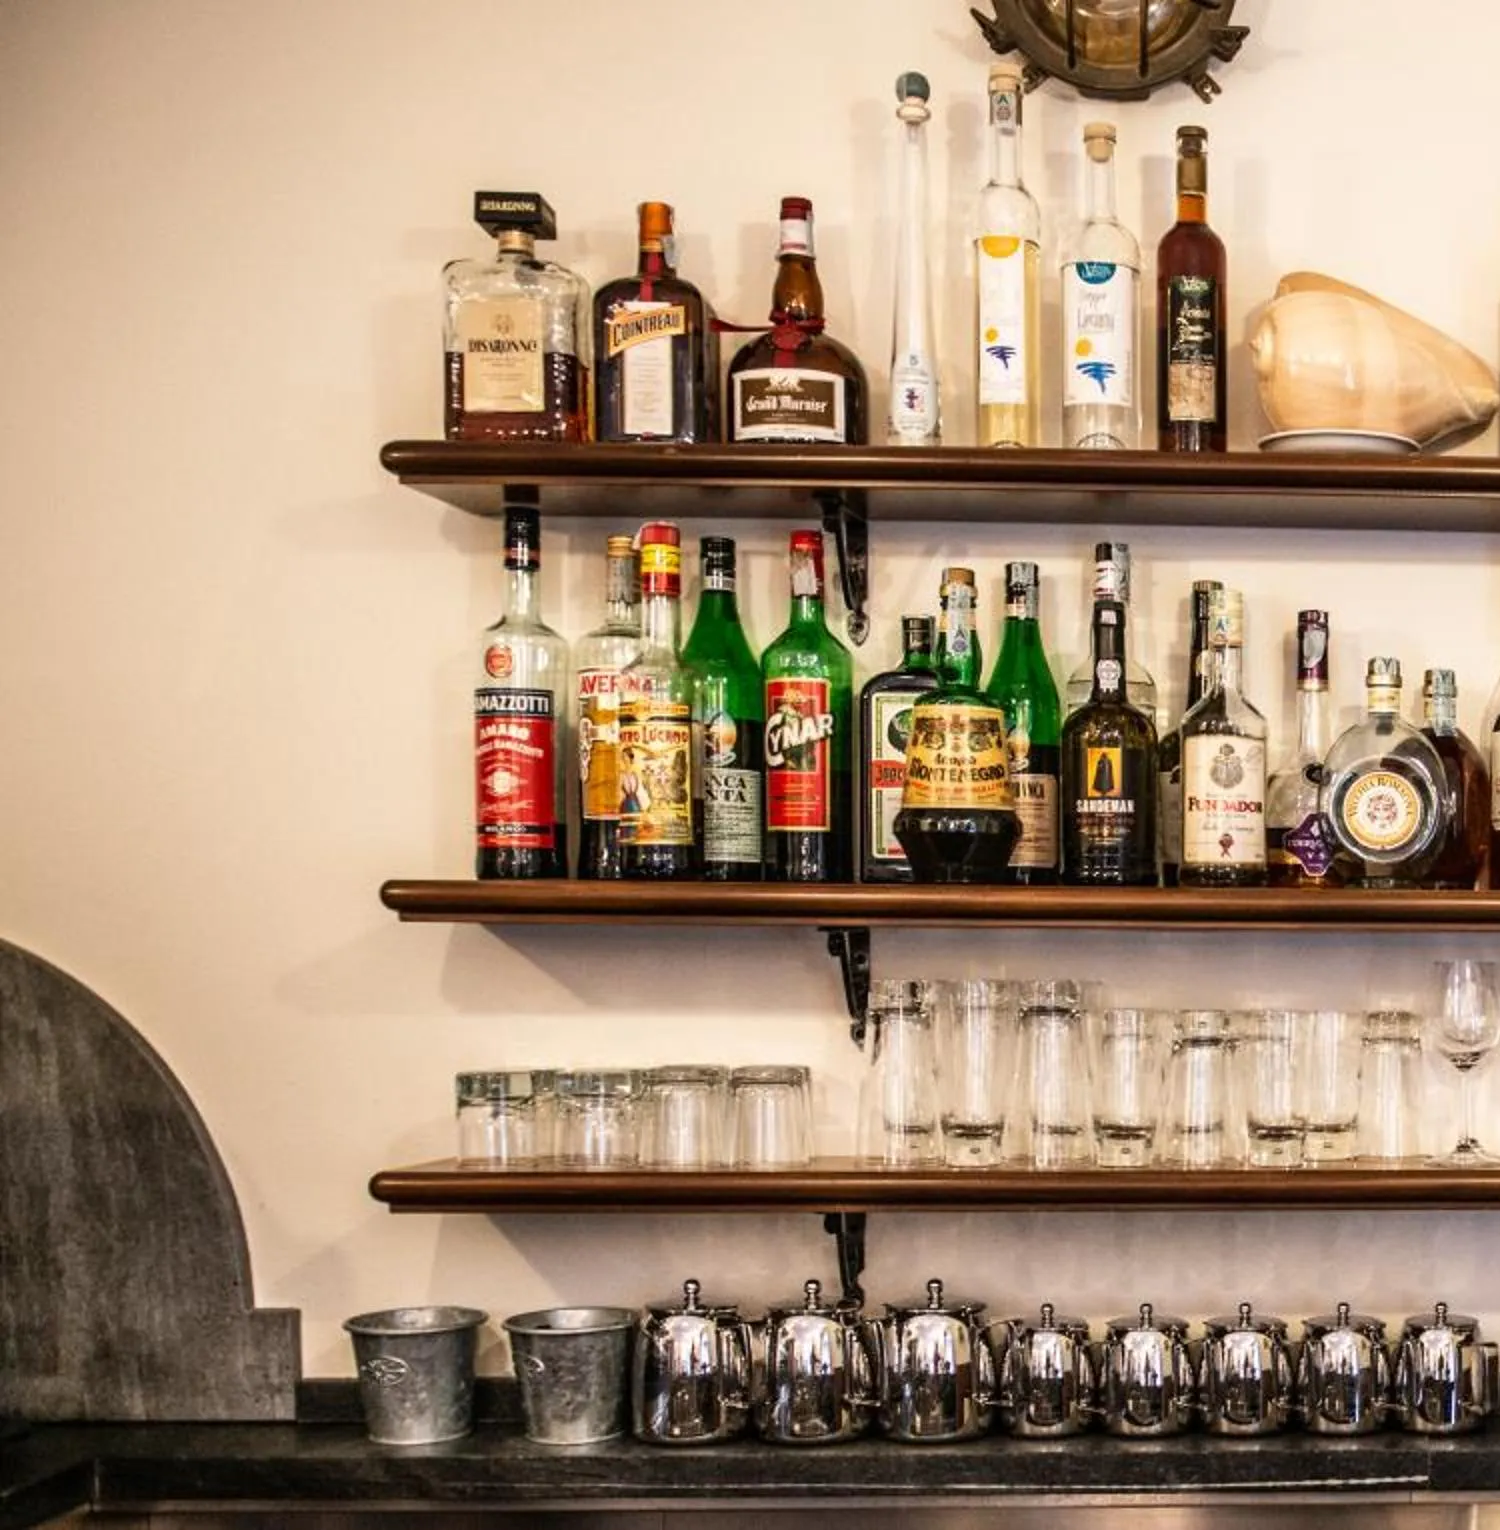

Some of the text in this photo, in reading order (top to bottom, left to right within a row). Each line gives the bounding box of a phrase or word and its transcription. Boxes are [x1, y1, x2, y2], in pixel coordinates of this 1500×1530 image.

[613, 312, 681, 347] COINTREAU
[468, 339, 537, 352] DISARONNO
[779, 395, 828, 413] Marnier
[765, 713, 834, 768] CYNAR
[909, 757, 1005, 781] MONTENEGRO
[1076, 799, 1135, 812] SANDEMAN
